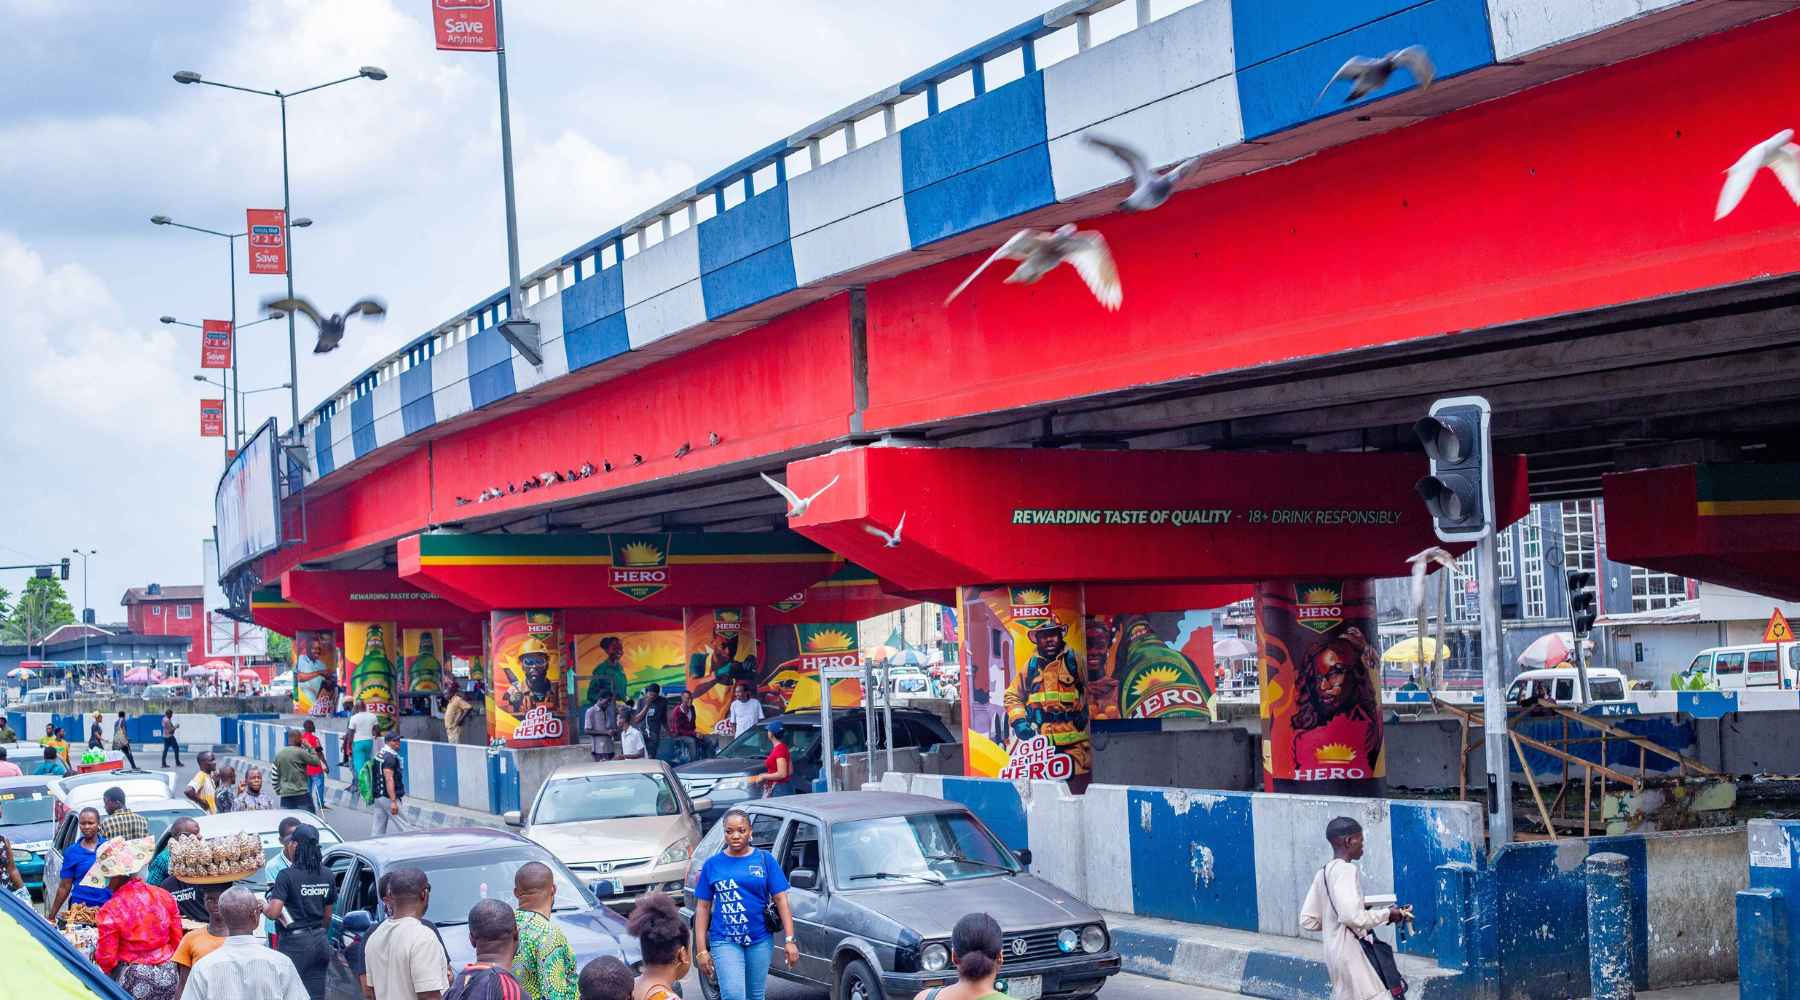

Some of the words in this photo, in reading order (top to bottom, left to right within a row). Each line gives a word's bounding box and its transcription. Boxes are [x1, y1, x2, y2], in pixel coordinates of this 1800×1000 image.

[445, 18, 483, 32] Save
[448, 35, 484, 45] Anytime
[256, 252, 279, 263] Save
[1012, 510, 1100, 524] REWARDING
[1104, 510, 1147, 524] TASTE
[1150, 510, 1169, 524] OF
[1171, 510, 1232, 526] QUALITY
[1248, 510, 1269, 523] 18+
[1272, 510, 1313, 524] DRINK
[1315, 511, 1402, 525] RESPONSIBLY
[614, 571, 666, 581] HERO
[1013, 607, 1049, 616] HERO
[1299, 607, 1341, 617] HERO
[802, 655, 856, 669] HERO
[366, 703, 395, 714] ERO
[528, 707, 545, 720] GO
[515, 723, 561, 737] HERO
[1020, 738, 1045, 755] GO
[1011, 757, 1025, 767] BE
[1027, 747, 1055, 763] THE
[1001, 756, 1070, 780] HERO
[1294, 768, 1364, 781] HERO
[301, 887, 329, 898] Galaxy
